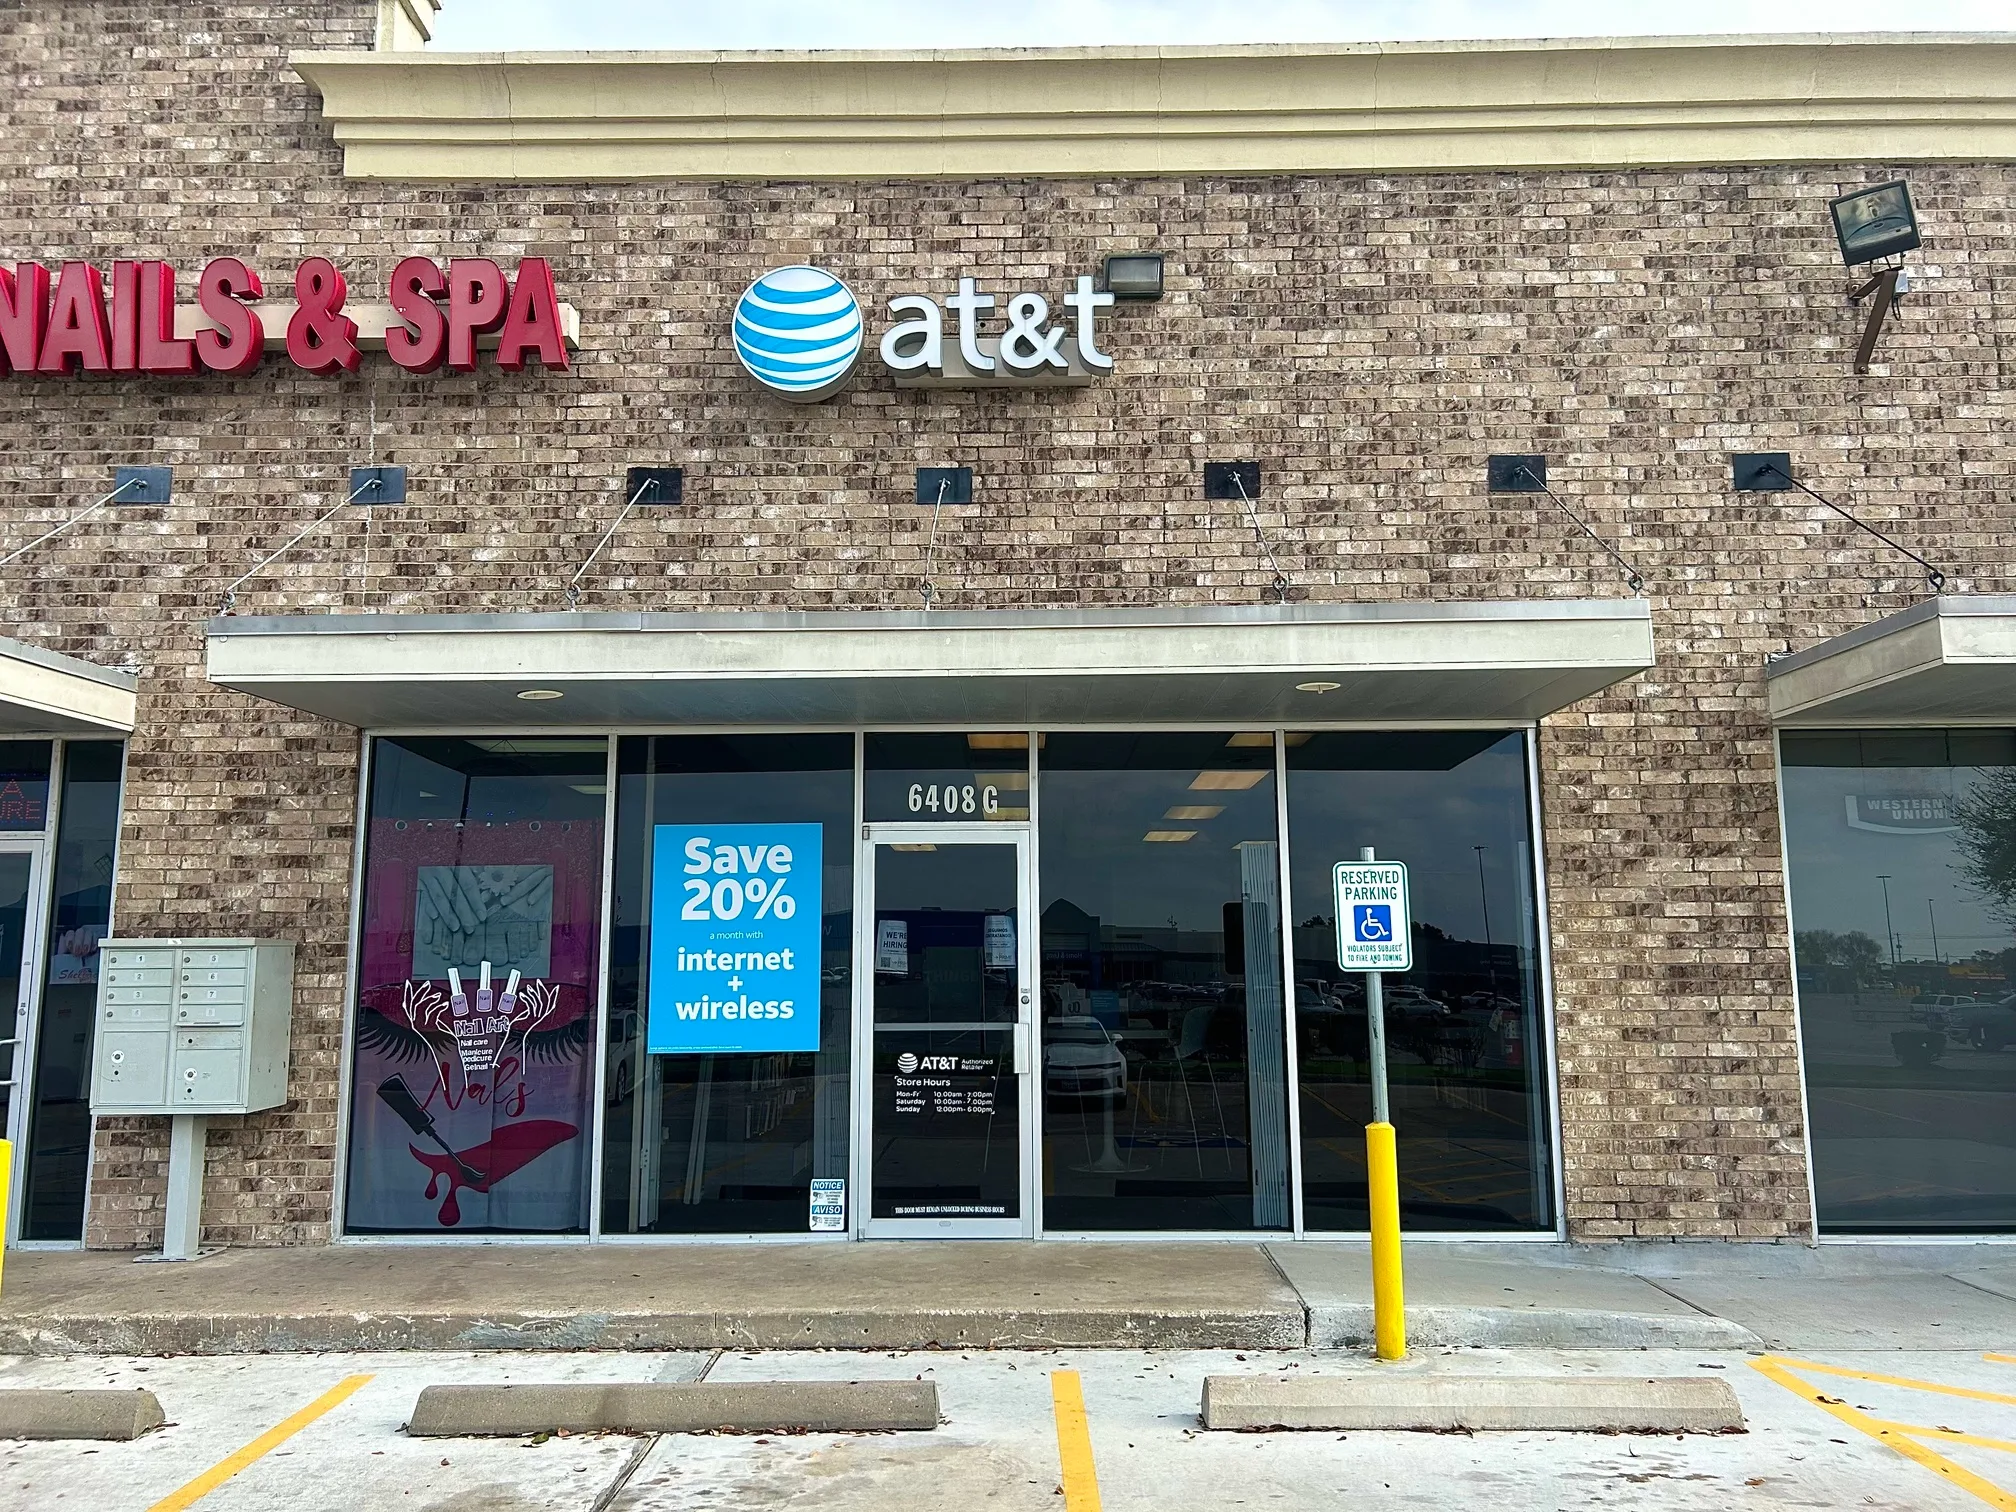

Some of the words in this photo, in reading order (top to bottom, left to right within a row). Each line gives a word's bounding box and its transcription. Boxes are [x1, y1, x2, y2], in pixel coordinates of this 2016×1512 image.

[286, 256, 363, 376] &
[385, 256, 570, 375] SPA
[880, 275, 1115, 379] at&t
[0, 779, 25, 799] A
[908, 783, 976, 814] 6408
[982, 785, 999, 814] G
[1867, 799, 1944, 811] WESTERN
[1892, 809, 1944, 820] UNION
[683, 836, 793, 875] Save
[1341, 870, 1399, 884] RESERVED
[681, 877, 796, 921] 20%
[1345, 887, 1397, 900] PARKING
[709, 932, 715, 940] a
[716, 931, 744, 940] month
[745, 930, 764, 939] with
[886, 931, 907, 939] WE'RE
[1378, 944, 1402, 952] SUBJECT
[677, 946, 795, 972] internet
[1370, 954, 1380, 962] AND
[1382, 954, 1402, 962] TOWING
[727, 975, 744, 992] +
[675, 994, 795, 1020] wireless
[454, 1018, 484, 1036] Nail
[486, 1015, 509, 1033] Art
[461, 1048, 493, 1056] Manicure
[920, 1057, 959, 1070] AT&T
[896, 1078, 922, 1086] Store
[923, 1078, 951, 1086] Hours
[813, 1181, 842, 1189] NOTICE
[813, 1206, 841, 1214] AVISO
